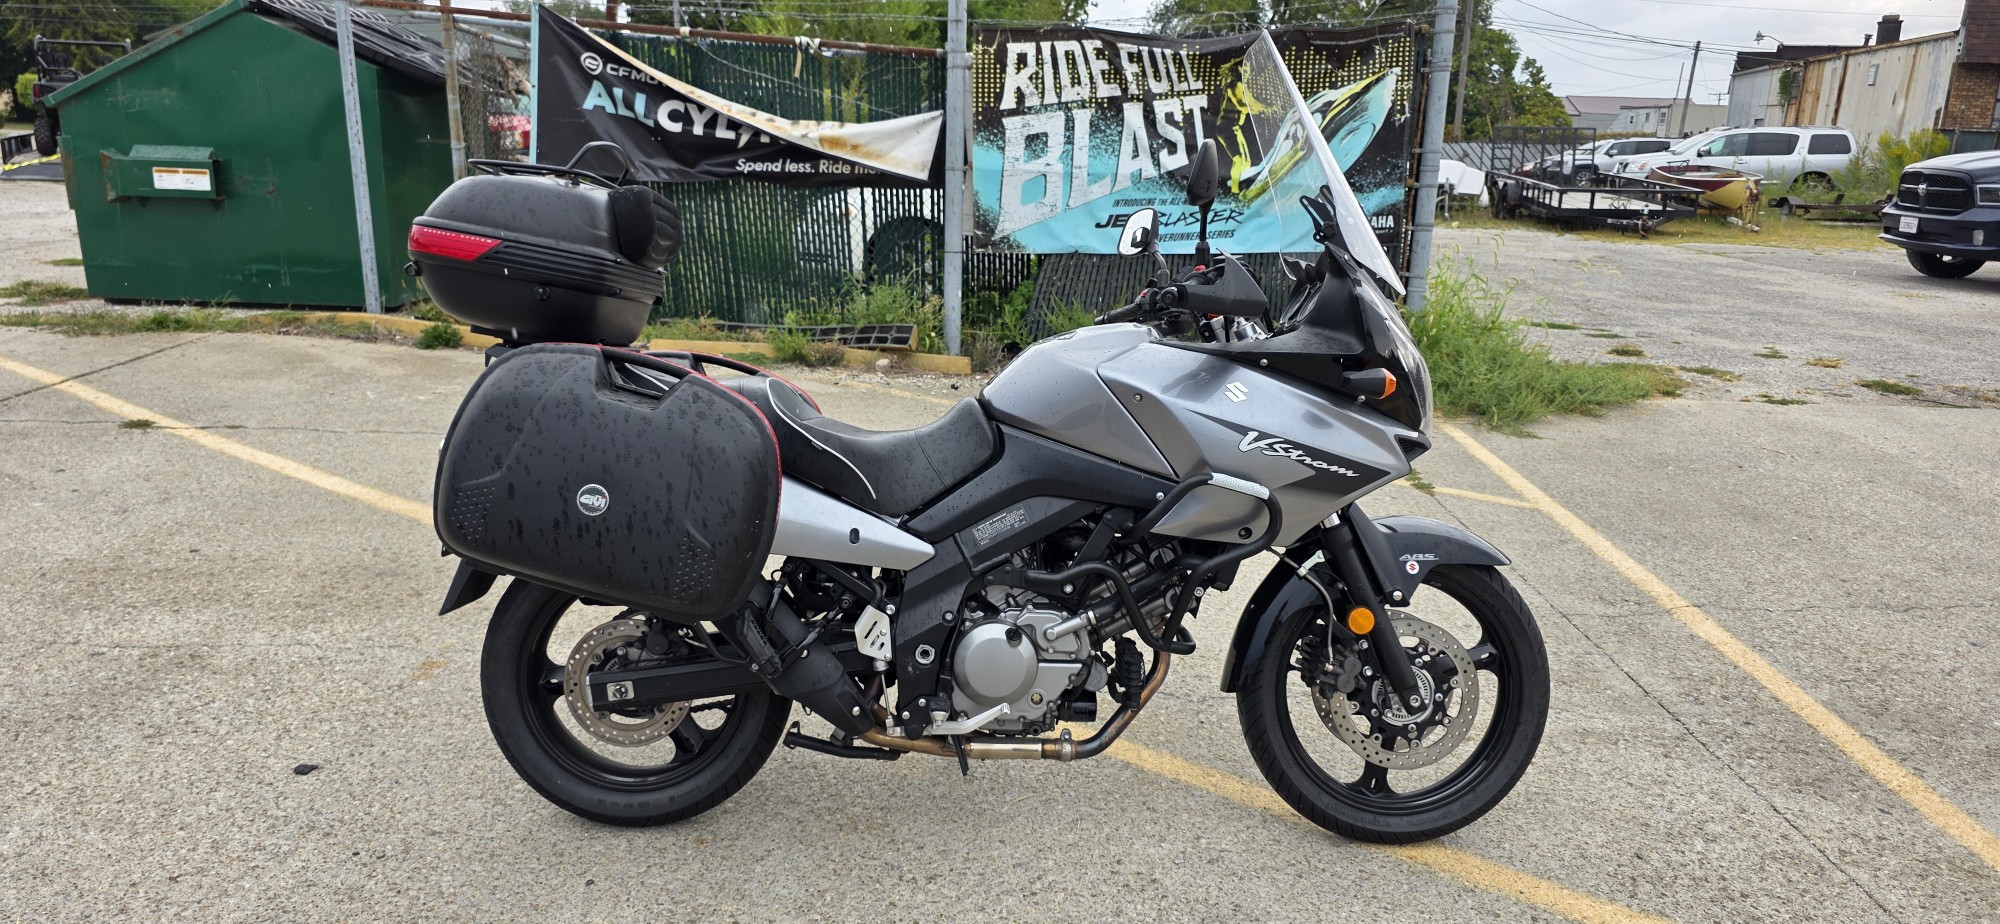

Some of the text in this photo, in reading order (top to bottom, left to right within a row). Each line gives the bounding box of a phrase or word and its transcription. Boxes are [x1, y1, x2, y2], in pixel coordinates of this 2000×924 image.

[1000, 39, 1204, 110] RIDE FULL
[582, 79, 655, 128] ALL
[735, 158, 783, 174] Spend
[785, 159, 815, 173] less.
[819, 159, 851, 174] Ride
[992, 94, 1208, 239] BLAST
[1112, 197, 1157, 208] INTRODUCING
[1206, 229, 1237, 240] SERIES
[1399, 553, 1437, 561] ABS
